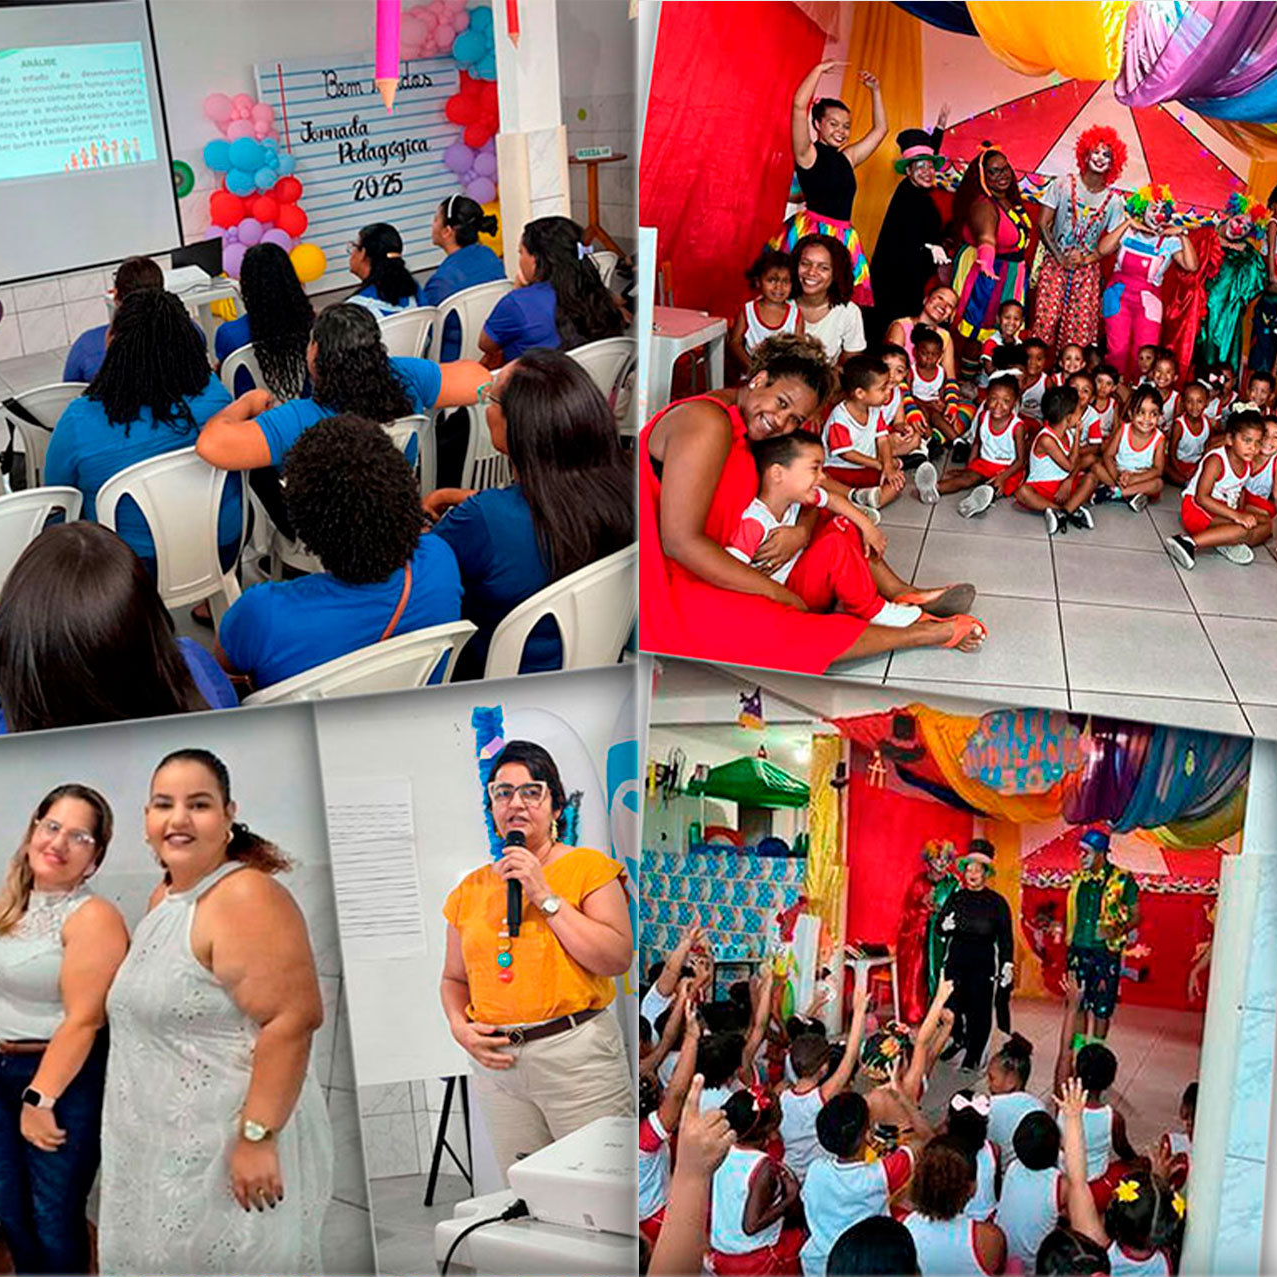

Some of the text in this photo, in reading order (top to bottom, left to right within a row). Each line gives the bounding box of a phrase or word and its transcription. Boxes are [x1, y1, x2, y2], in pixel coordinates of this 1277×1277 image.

[322, 69, 363, 99] Bem
[300, 115, 369, 143] Jornada
[338, 138, 430, 166] Pedagógica
[353, 171, 403, 201] 2025
